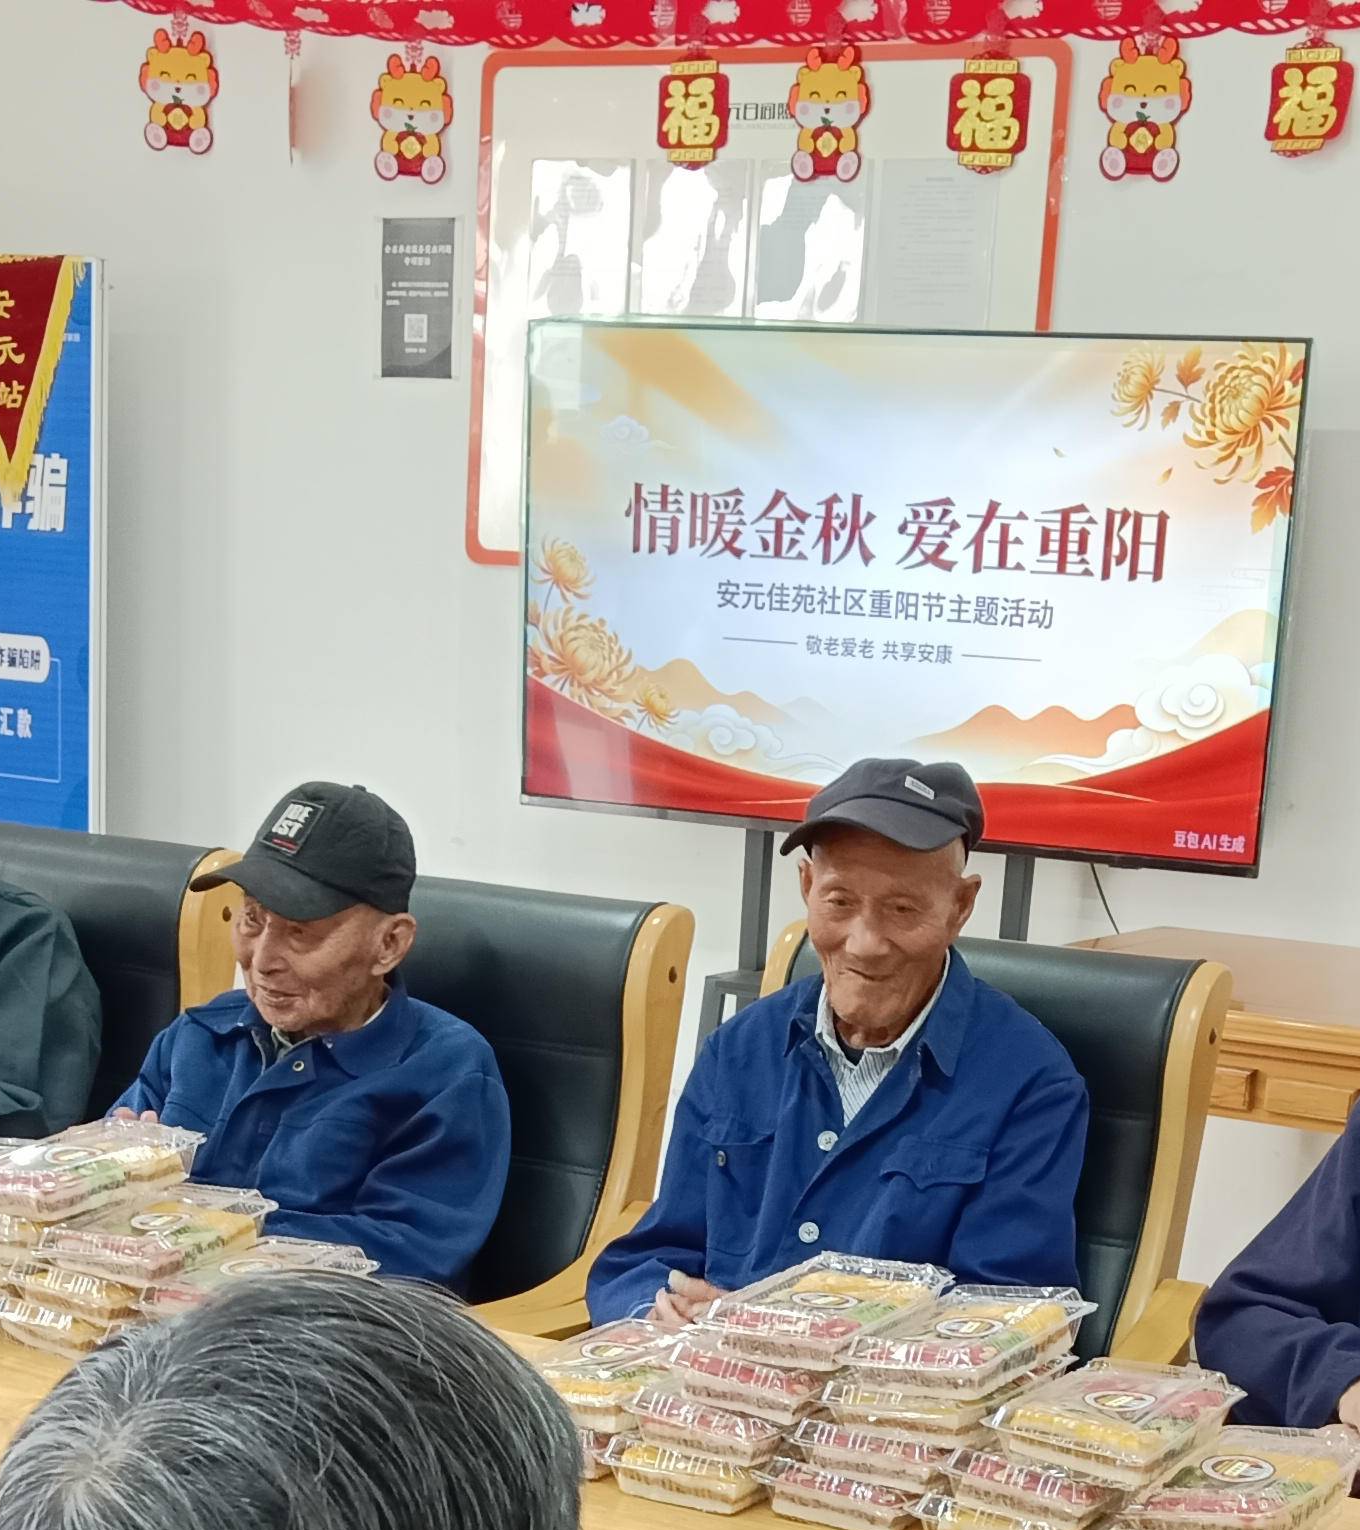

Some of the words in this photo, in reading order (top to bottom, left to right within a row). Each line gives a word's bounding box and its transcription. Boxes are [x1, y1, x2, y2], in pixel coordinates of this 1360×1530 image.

[664, 76, 720, 147] 福
[956, 77, 1020, 149] 福
[1273, 66, 1338, 135] 福
[624, 482, 878, 568] 情暖金秋
[896, 496, 1171, 583] 爱在重阳
[716, 579, 1055, 631] 安元佳苑社区重阳节主题活动
[806, 634, 875, 660] 敬老爱老
[882, 639, 953, 665] 共享安康
